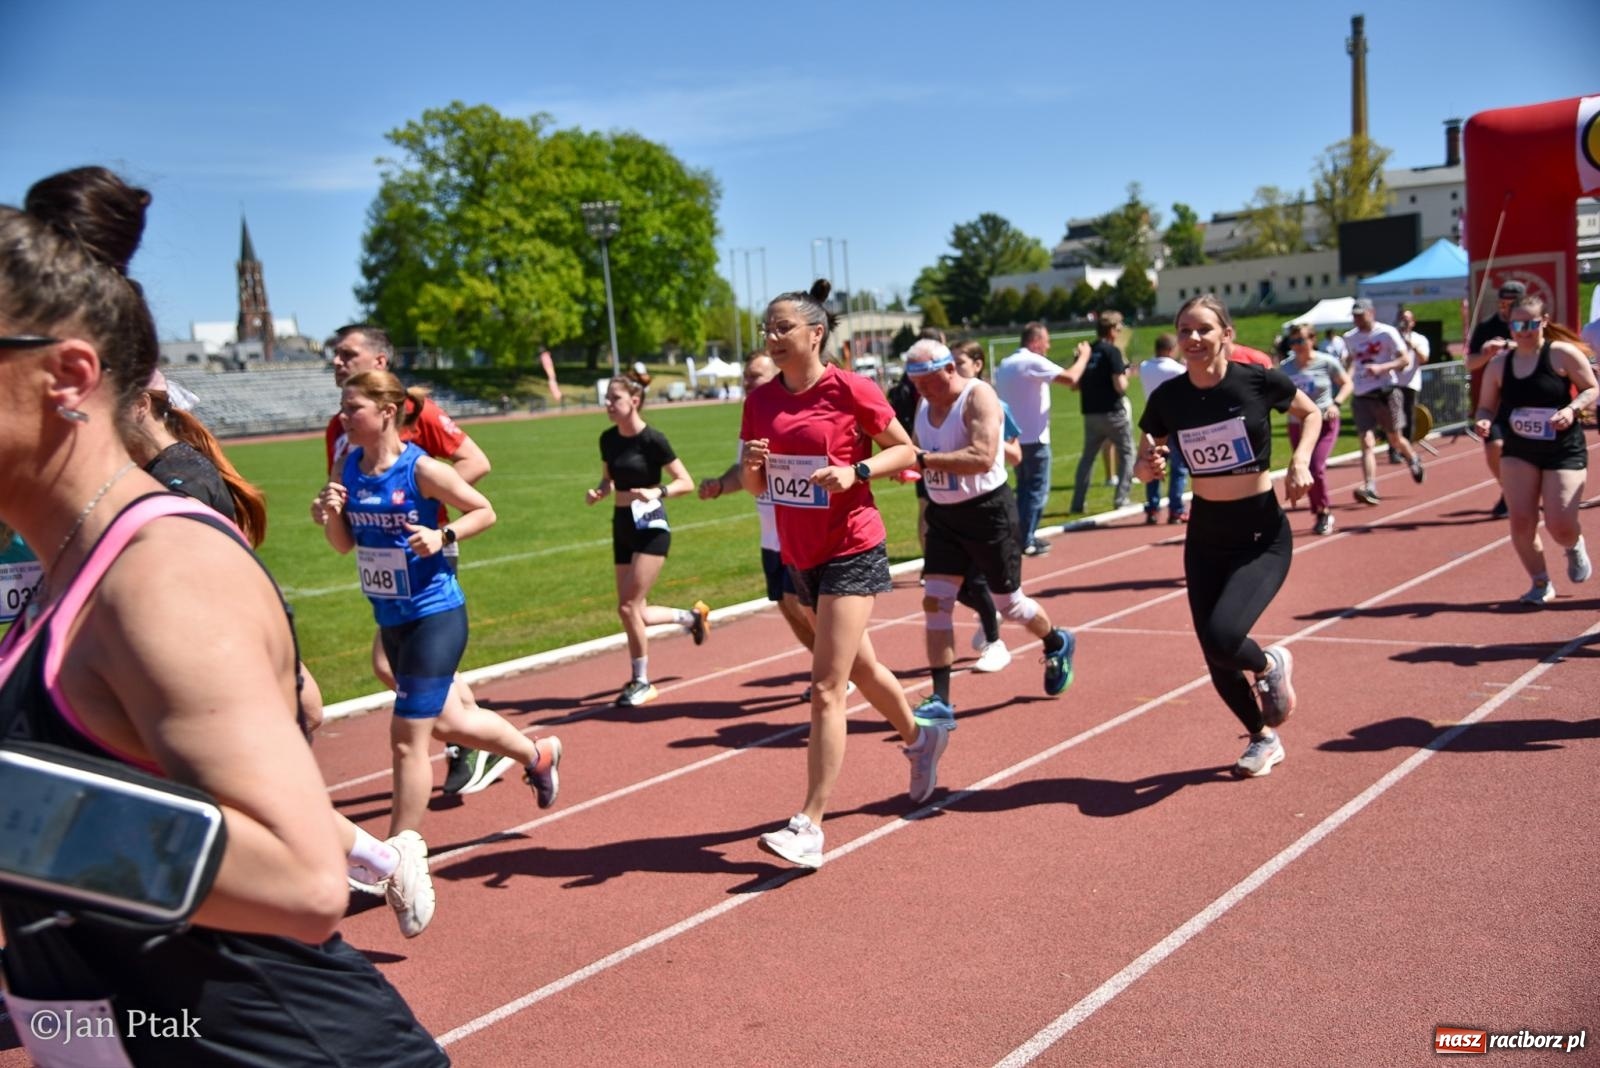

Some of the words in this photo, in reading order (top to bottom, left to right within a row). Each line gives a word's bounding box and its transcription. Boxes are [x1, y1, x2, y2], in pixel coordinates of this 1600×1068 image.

[1514, 420, 1542, 433] 055
[1192, 443, 1232, 465] 032
[774, 476, 811, 498] 042
[926, 470, 945, 485] 041
[363, 568, 394, 590] 048
[7, 586, 38, 610] 03
